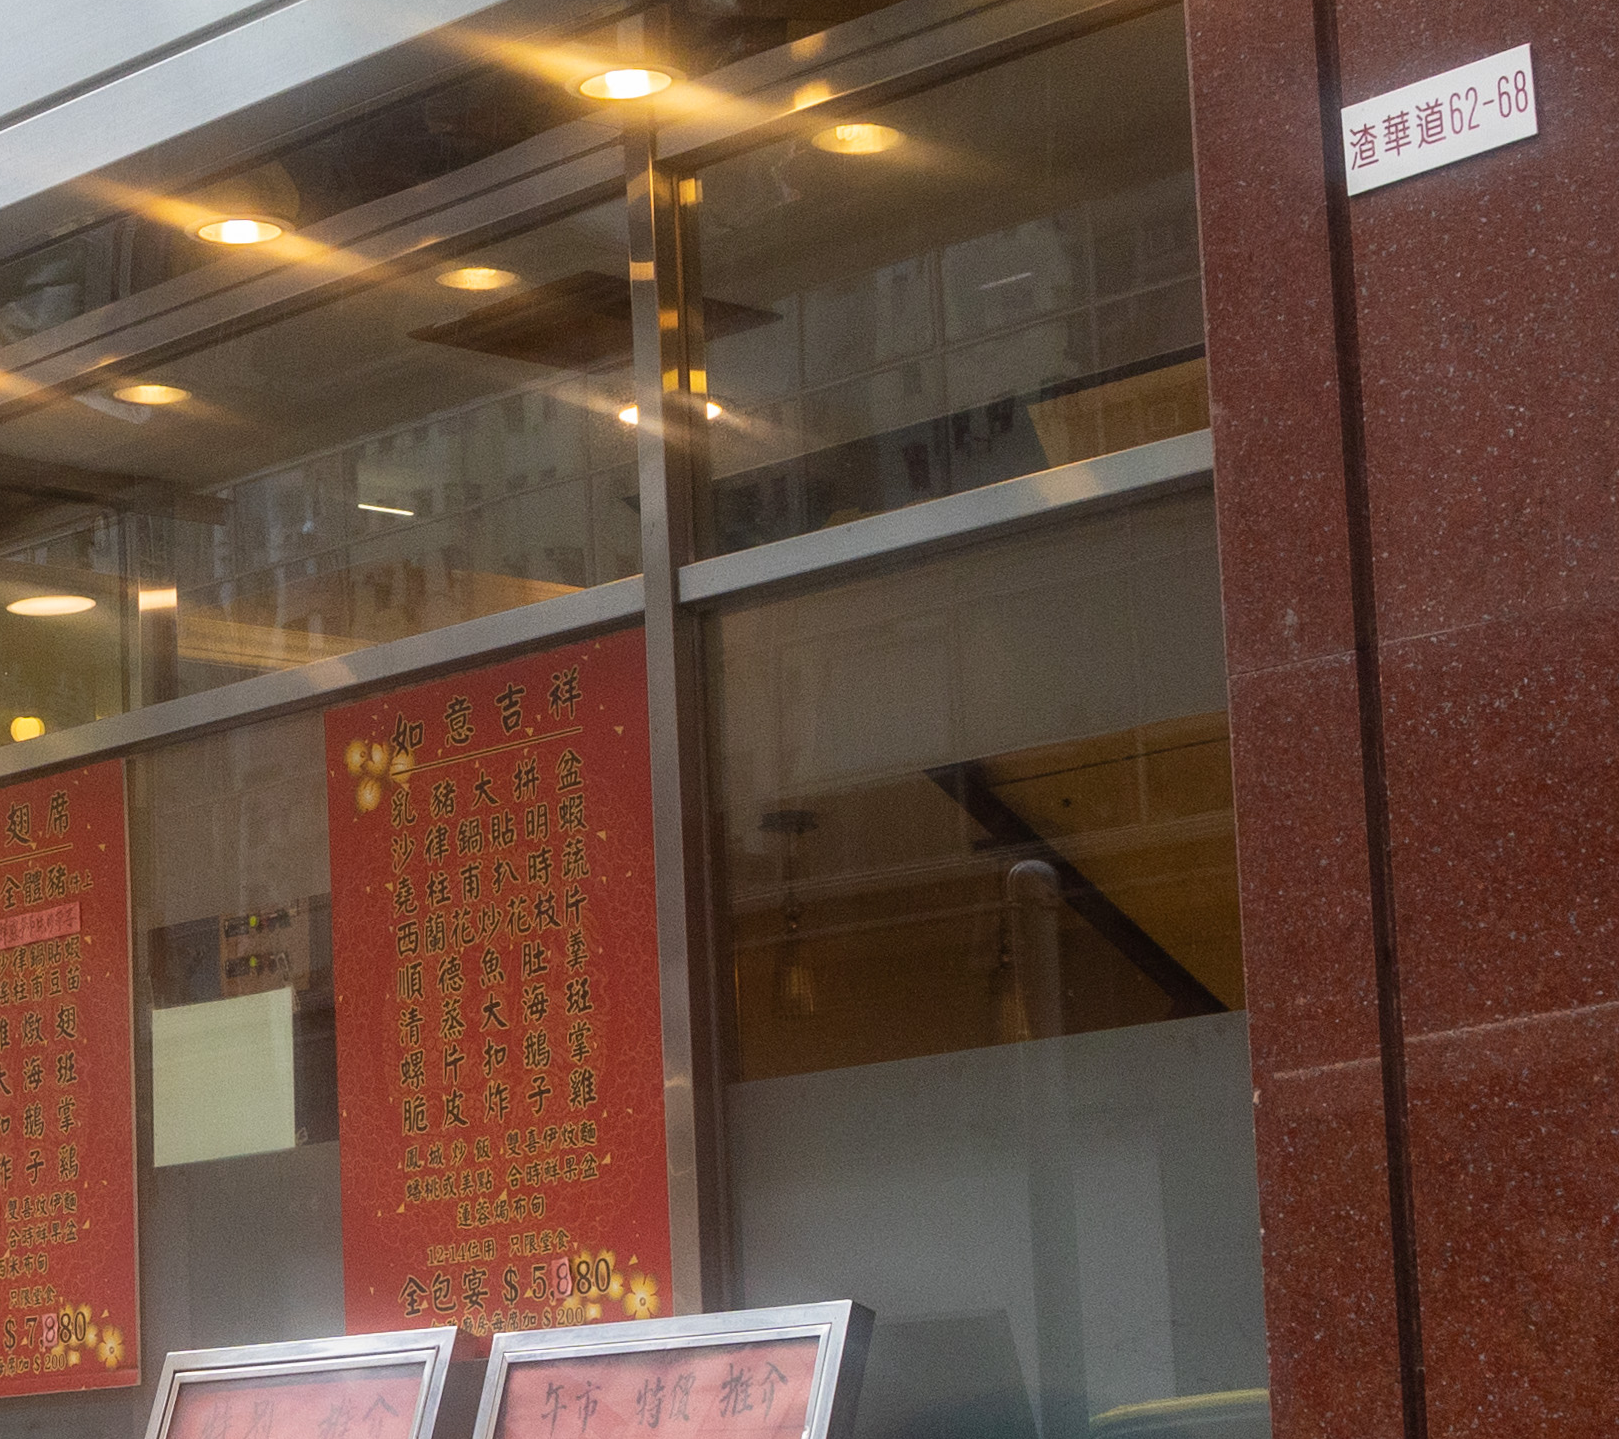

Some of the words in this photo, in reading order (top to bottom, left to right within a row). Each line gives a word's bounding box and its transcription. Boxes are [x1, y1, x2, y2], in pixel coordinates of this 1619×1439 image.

[1349, 69, 1530, 171] 渣華道62-68
[391, 665, 583, 757] 如意吉祥
[391, 748, 583, 828] 乳豬大拼盆
[391, 793, 588, 874] 沙律鍋貼明蝦
[396, 884, 588, 958] 西蘭花炒花枝片
[400, 1020, 592, 1090] 螺片扣鵝掌
[403, 1067, 597, 1135] 脆皮炸子雞
[399, 1267, 489, 1317] 全包宴
